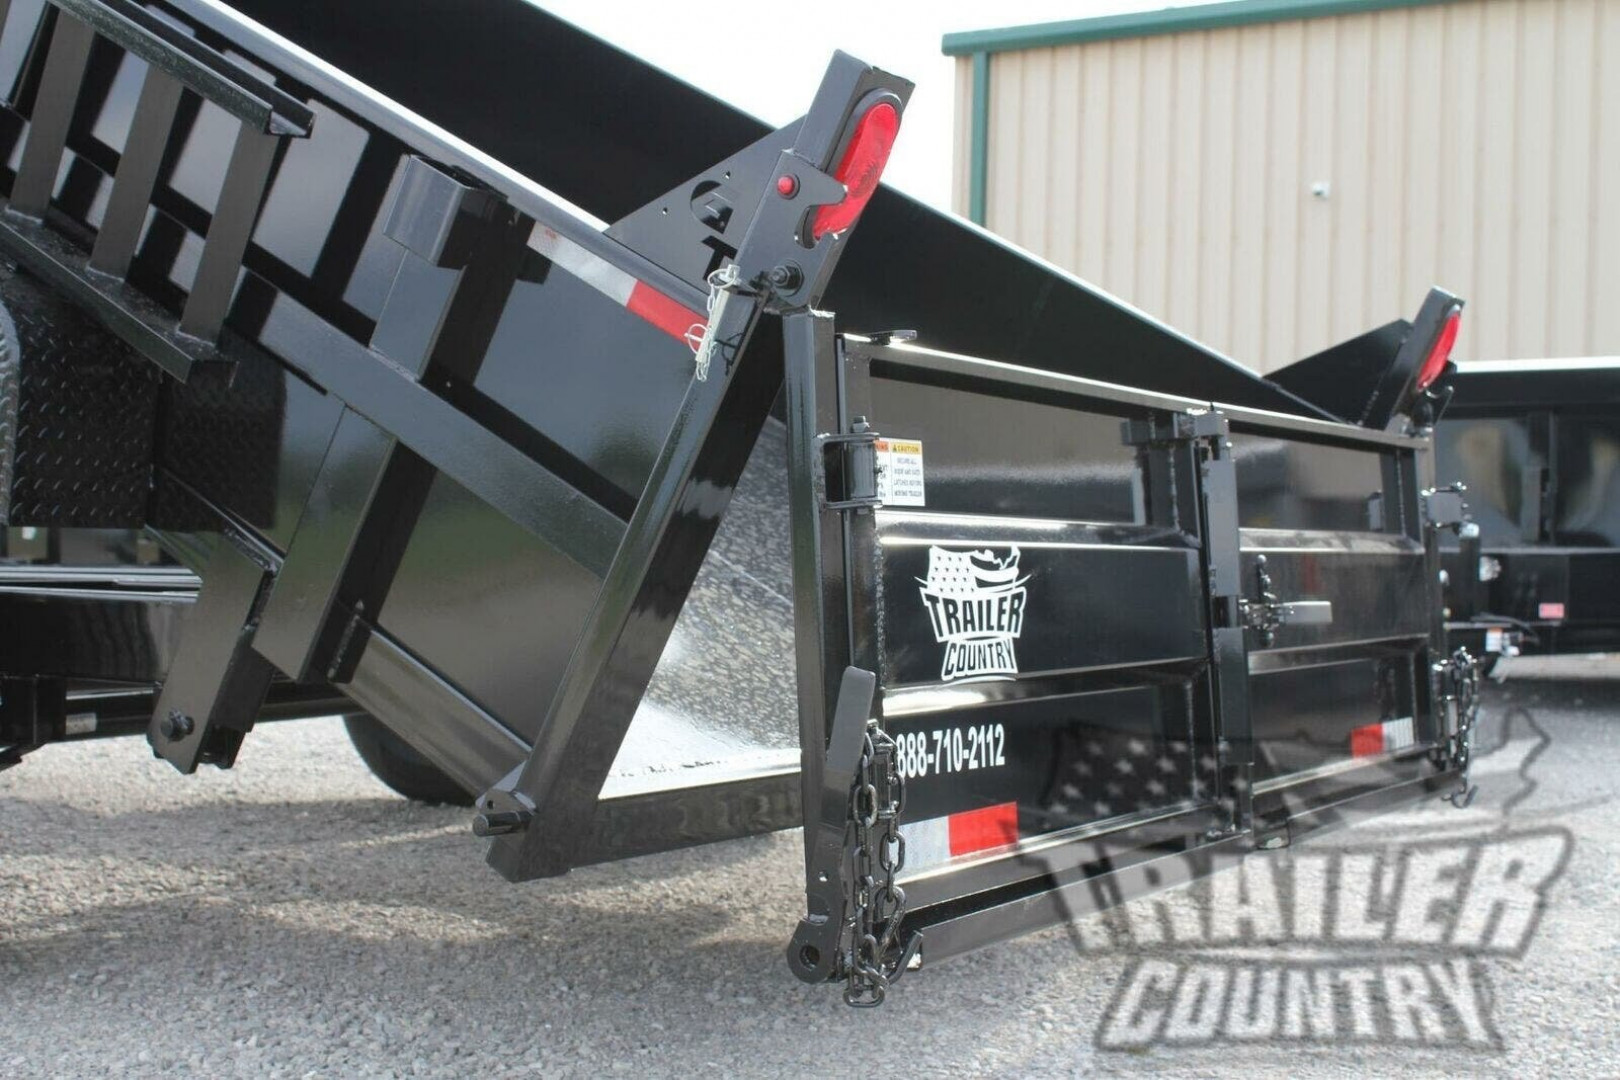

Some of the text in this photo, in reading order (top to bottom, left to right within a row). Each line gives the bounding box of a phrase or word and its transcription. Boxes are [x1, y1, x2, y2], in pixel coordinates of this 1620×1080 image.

[924, 591, 1024, 638] TRAILER
[944, 639, 1015, 676] COUNTRY
[896, 723, 1005, 778] 888-710-2112
